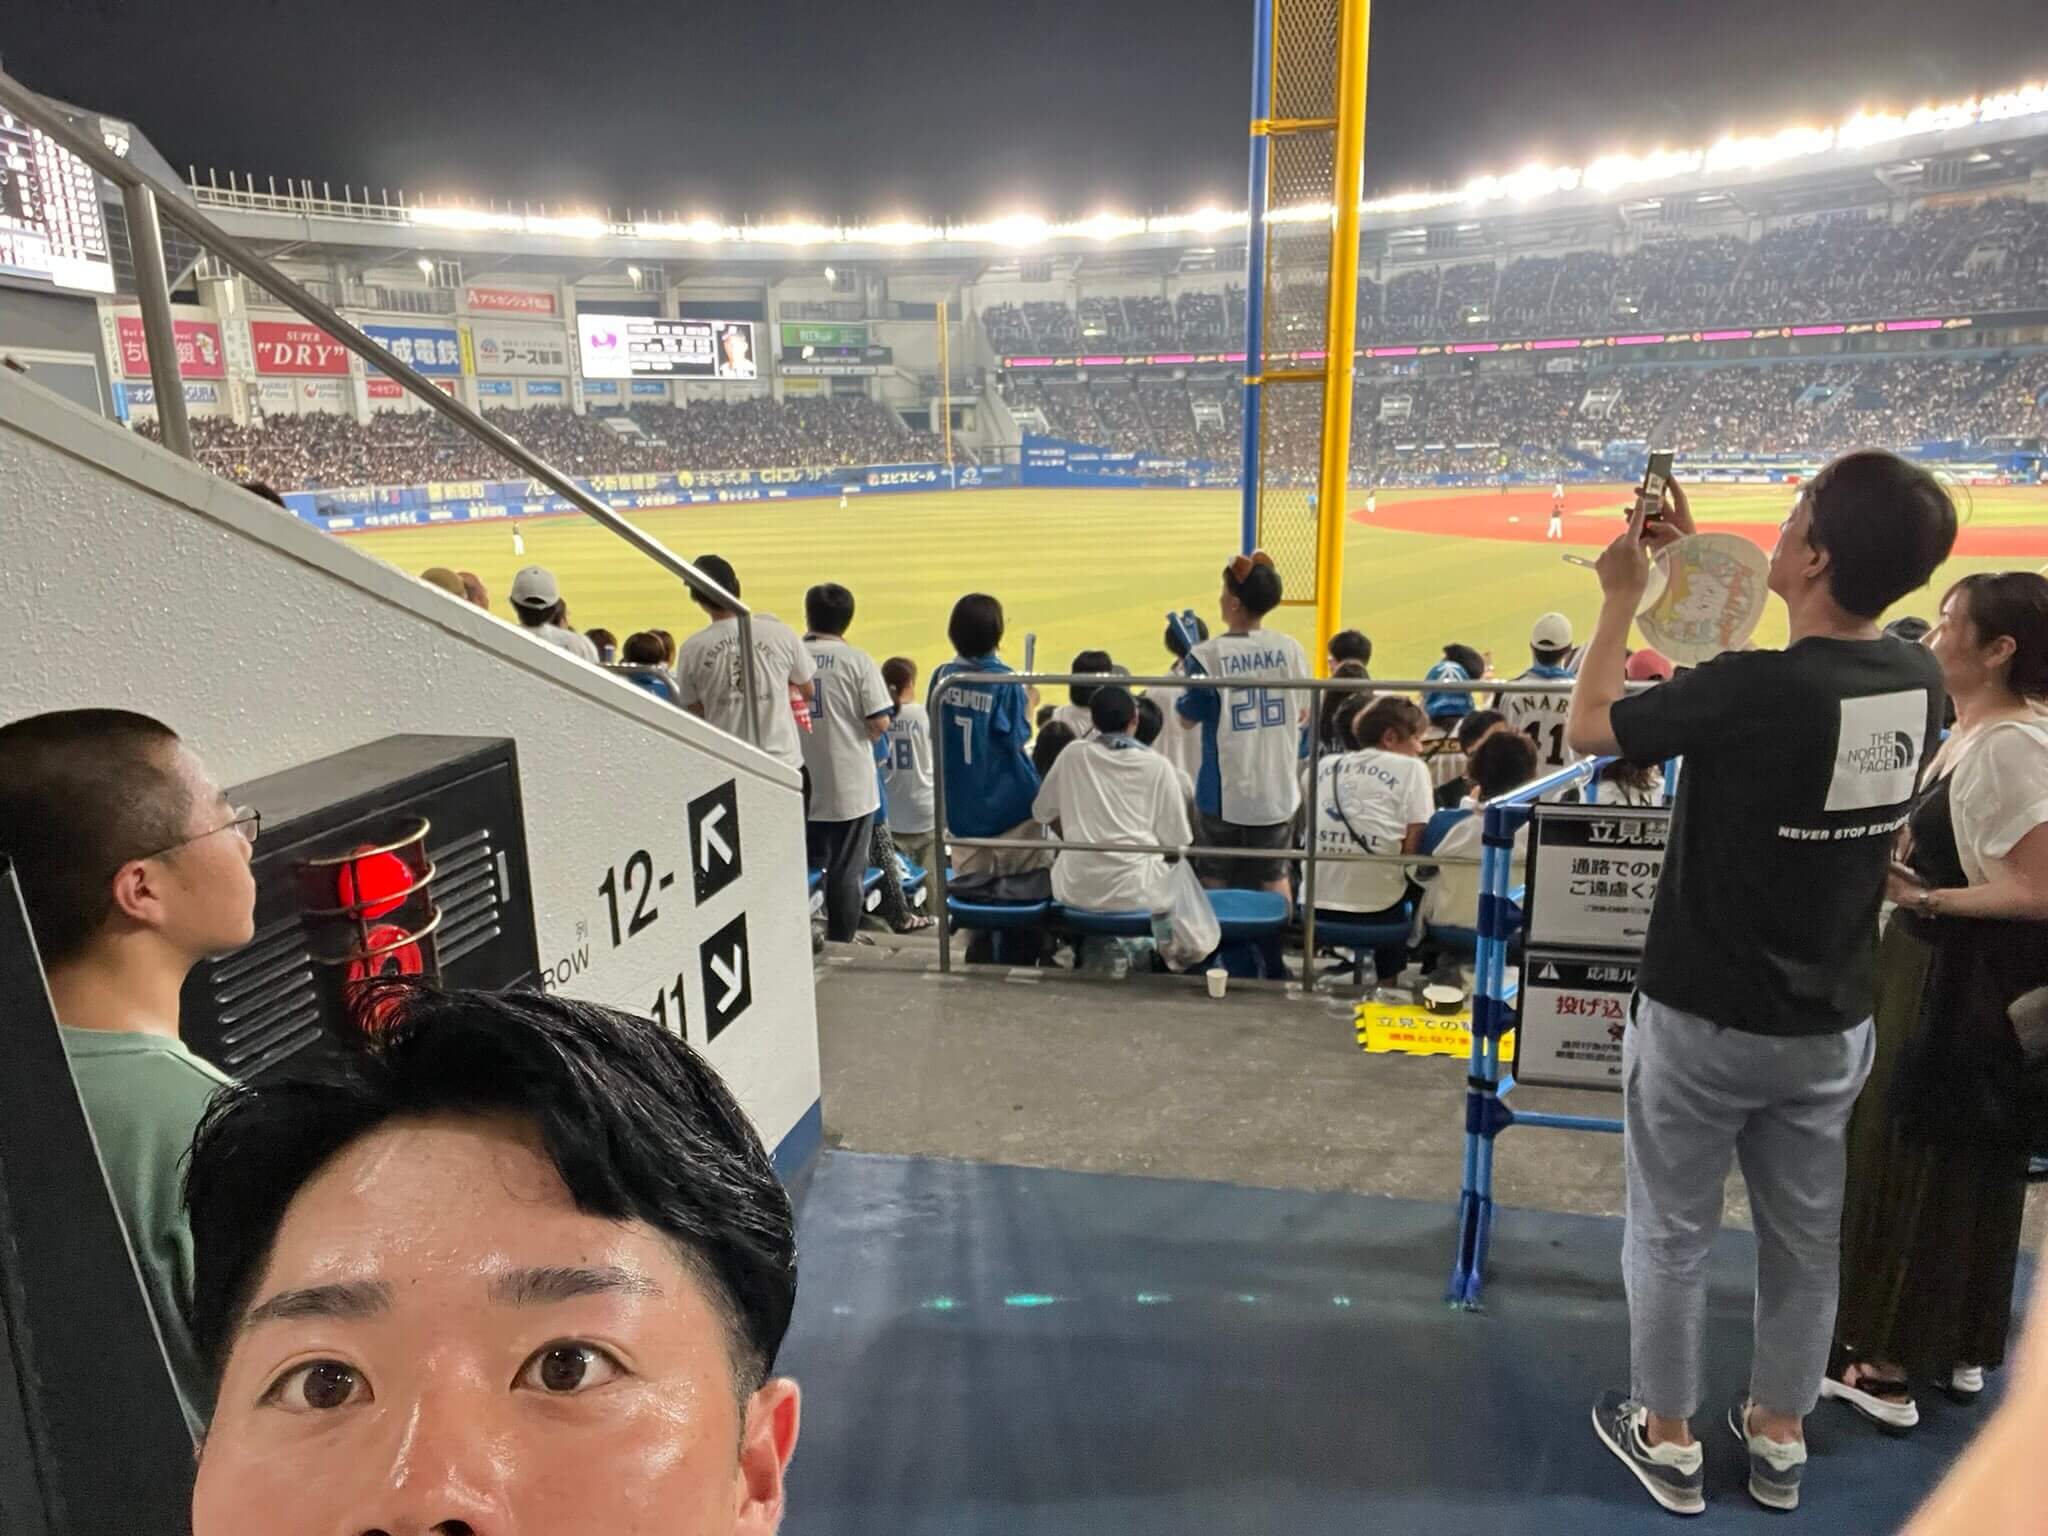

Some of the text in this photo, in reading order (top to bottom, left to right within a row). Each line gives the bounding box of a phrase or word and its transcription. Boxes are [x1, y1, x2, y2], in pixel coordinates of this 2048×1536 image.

[286, 331, 320, 342] SUPER
[1221, 650, 1286, 673] TANAKA
[1231, 687, 1285, 731] 26
[1512, 695, 1570, 716] INAB
[954, 716, 972, 765] 7
[1871, 732, 1894, 746] THE
[1848, 744, 1893, 763] NORTH
[1355, 762, 1400, 790] ROCK
[1860, 759, 1891, 774] FACE
[1778, 825, 1830, 840] NEVER
[1833, 826, 1867, 840] STOP
[598, 849, 674, 949] 12-
[541, 944, 589, 992] ROW
